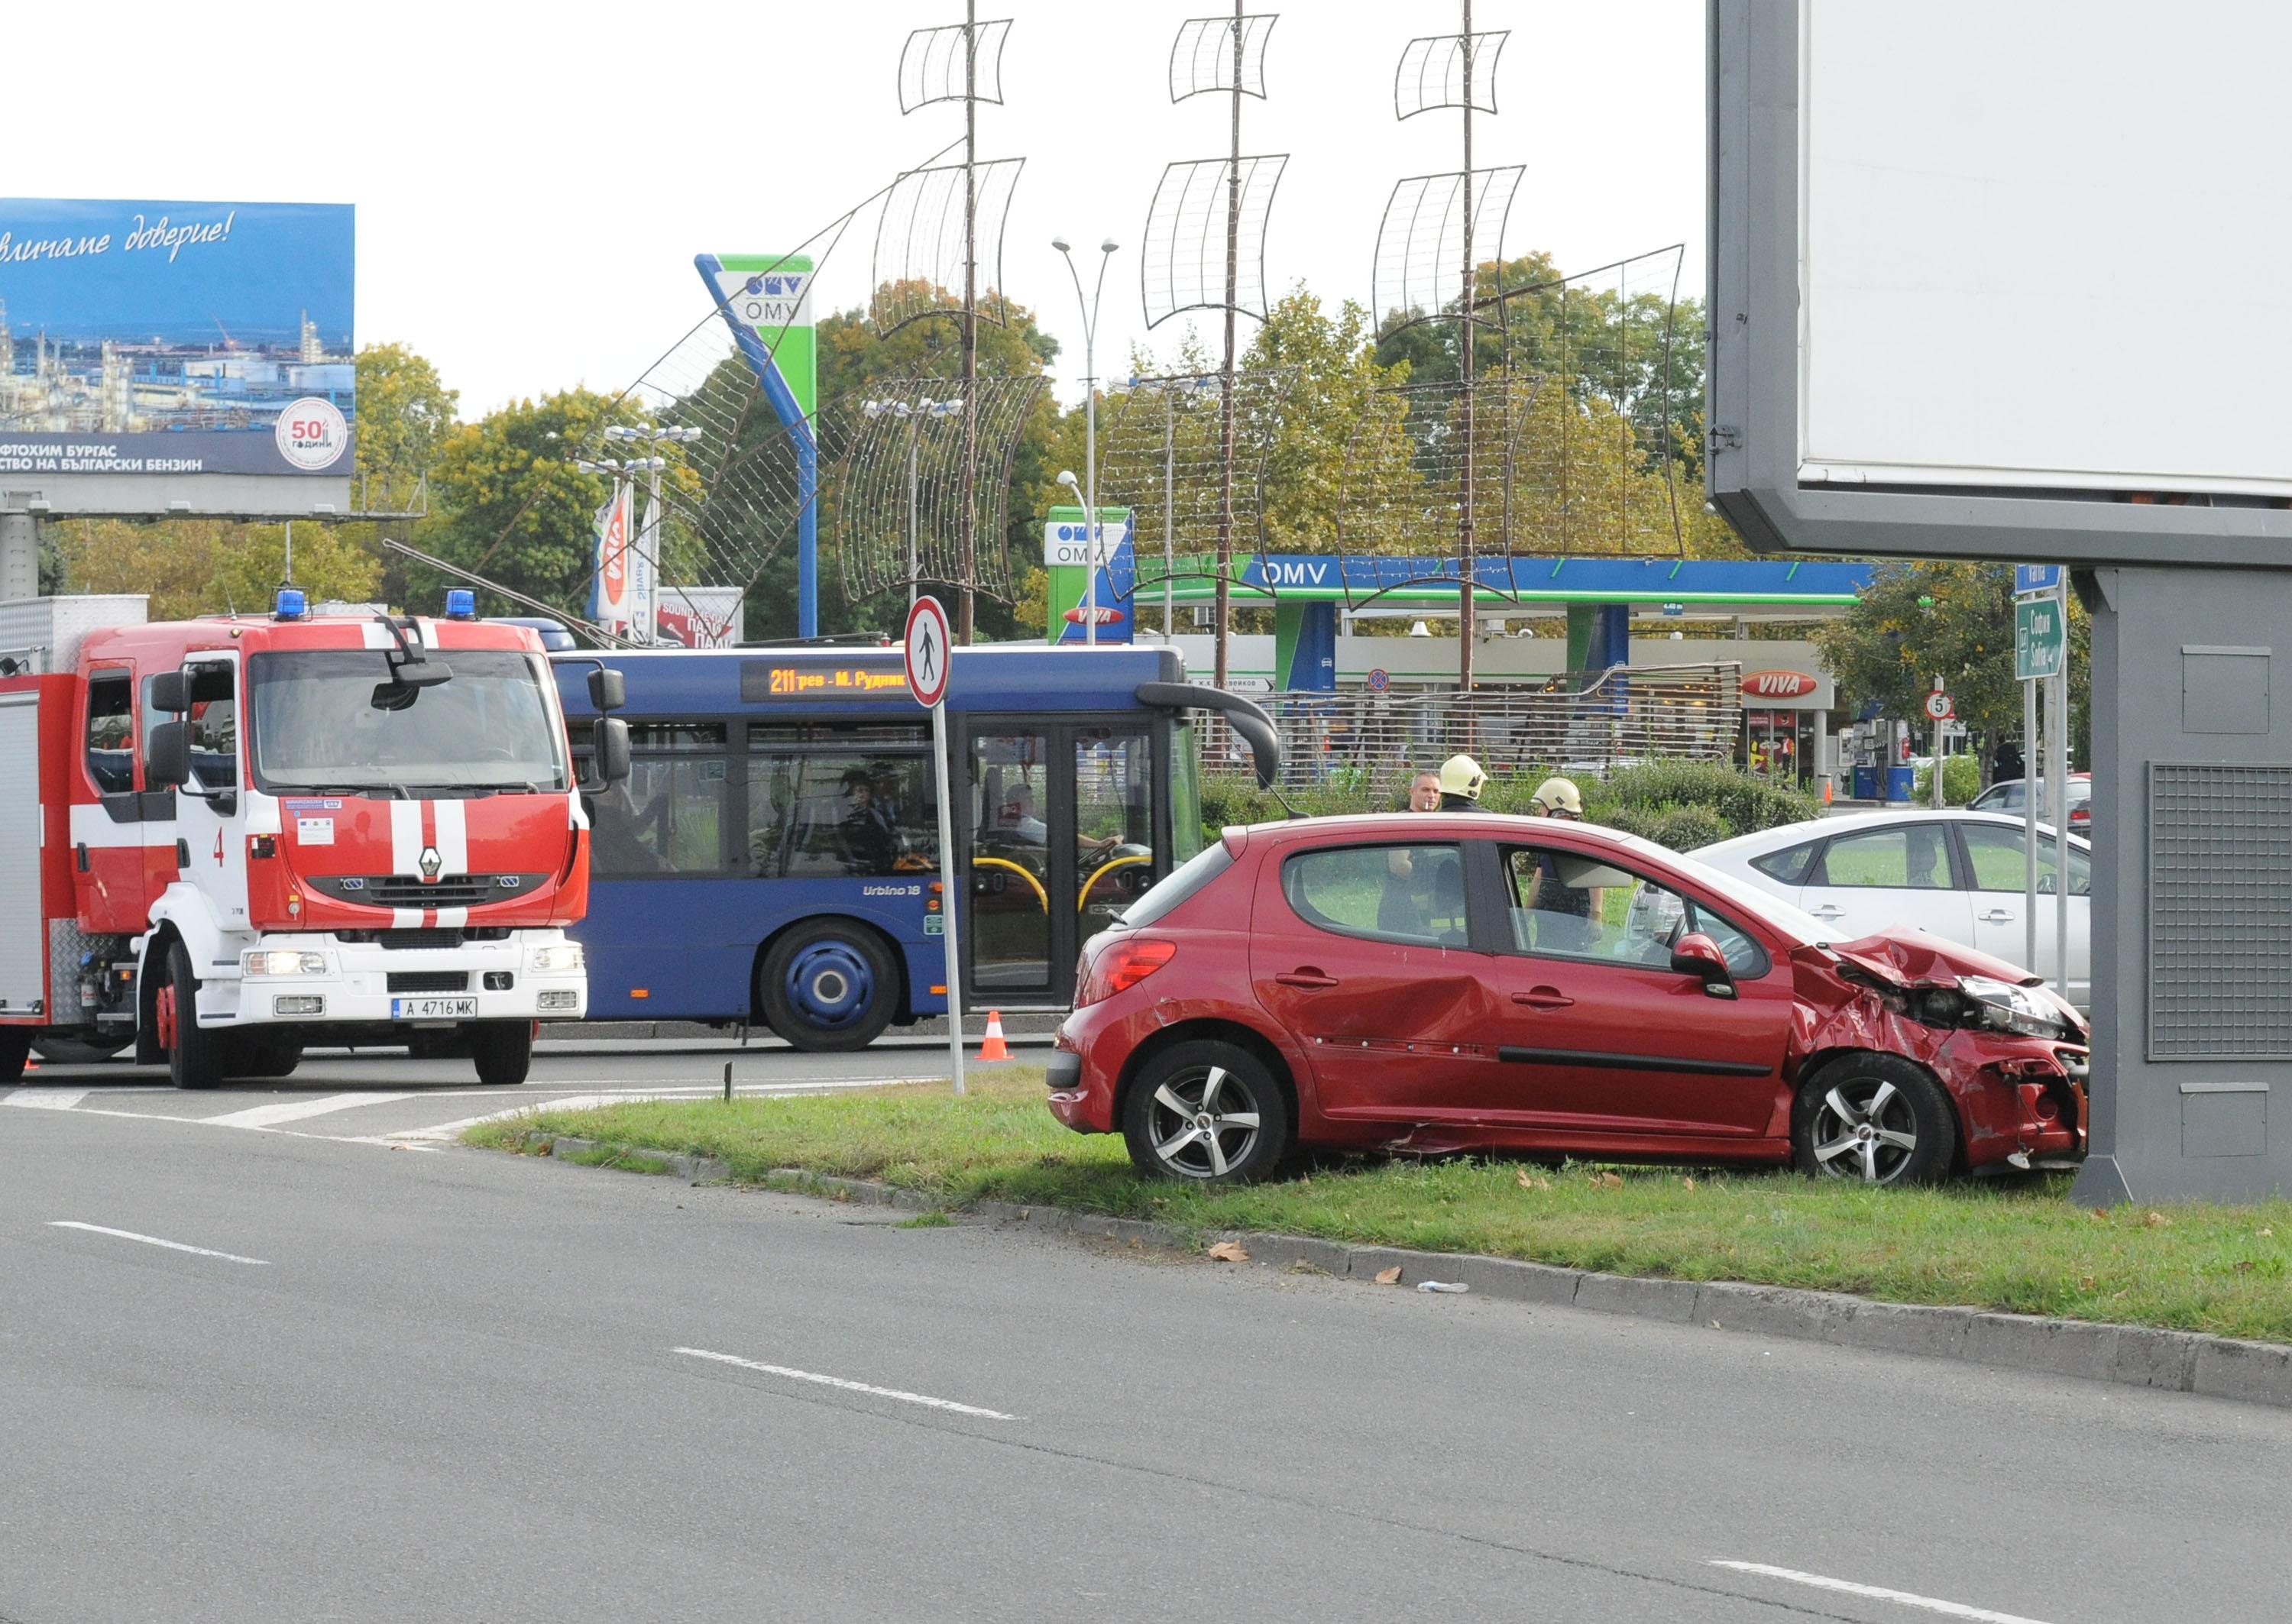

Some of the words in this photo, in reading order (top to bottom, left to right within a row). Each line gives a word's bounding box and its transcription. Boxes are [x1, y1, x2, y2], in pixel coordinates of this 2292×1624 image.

[125, 211, 235, 263] доверие!
[292, 420, 322, 439] 50
[66, 445, 117, 458] БУРГАС
[36, 458, 57, 471] НА
[61, 458, 142, 471] БЪЛГАРСКИ
[146, 459, 202, 471] БЕНЗИН
[1261, 562, 1328, 584] OMV
[770, 669, 795, 692] 211
[855, 671, 906, 690] Рудник
[1759, 675, 1800, 694] VIVA
[1934, 698, 1944, 713] 5
[213, 826, 224, 868] 4
[863, 885, 905, 896] Urbino
[906, 885, 921, 895] 18
[422, 1001, 454, 1015] 4716
